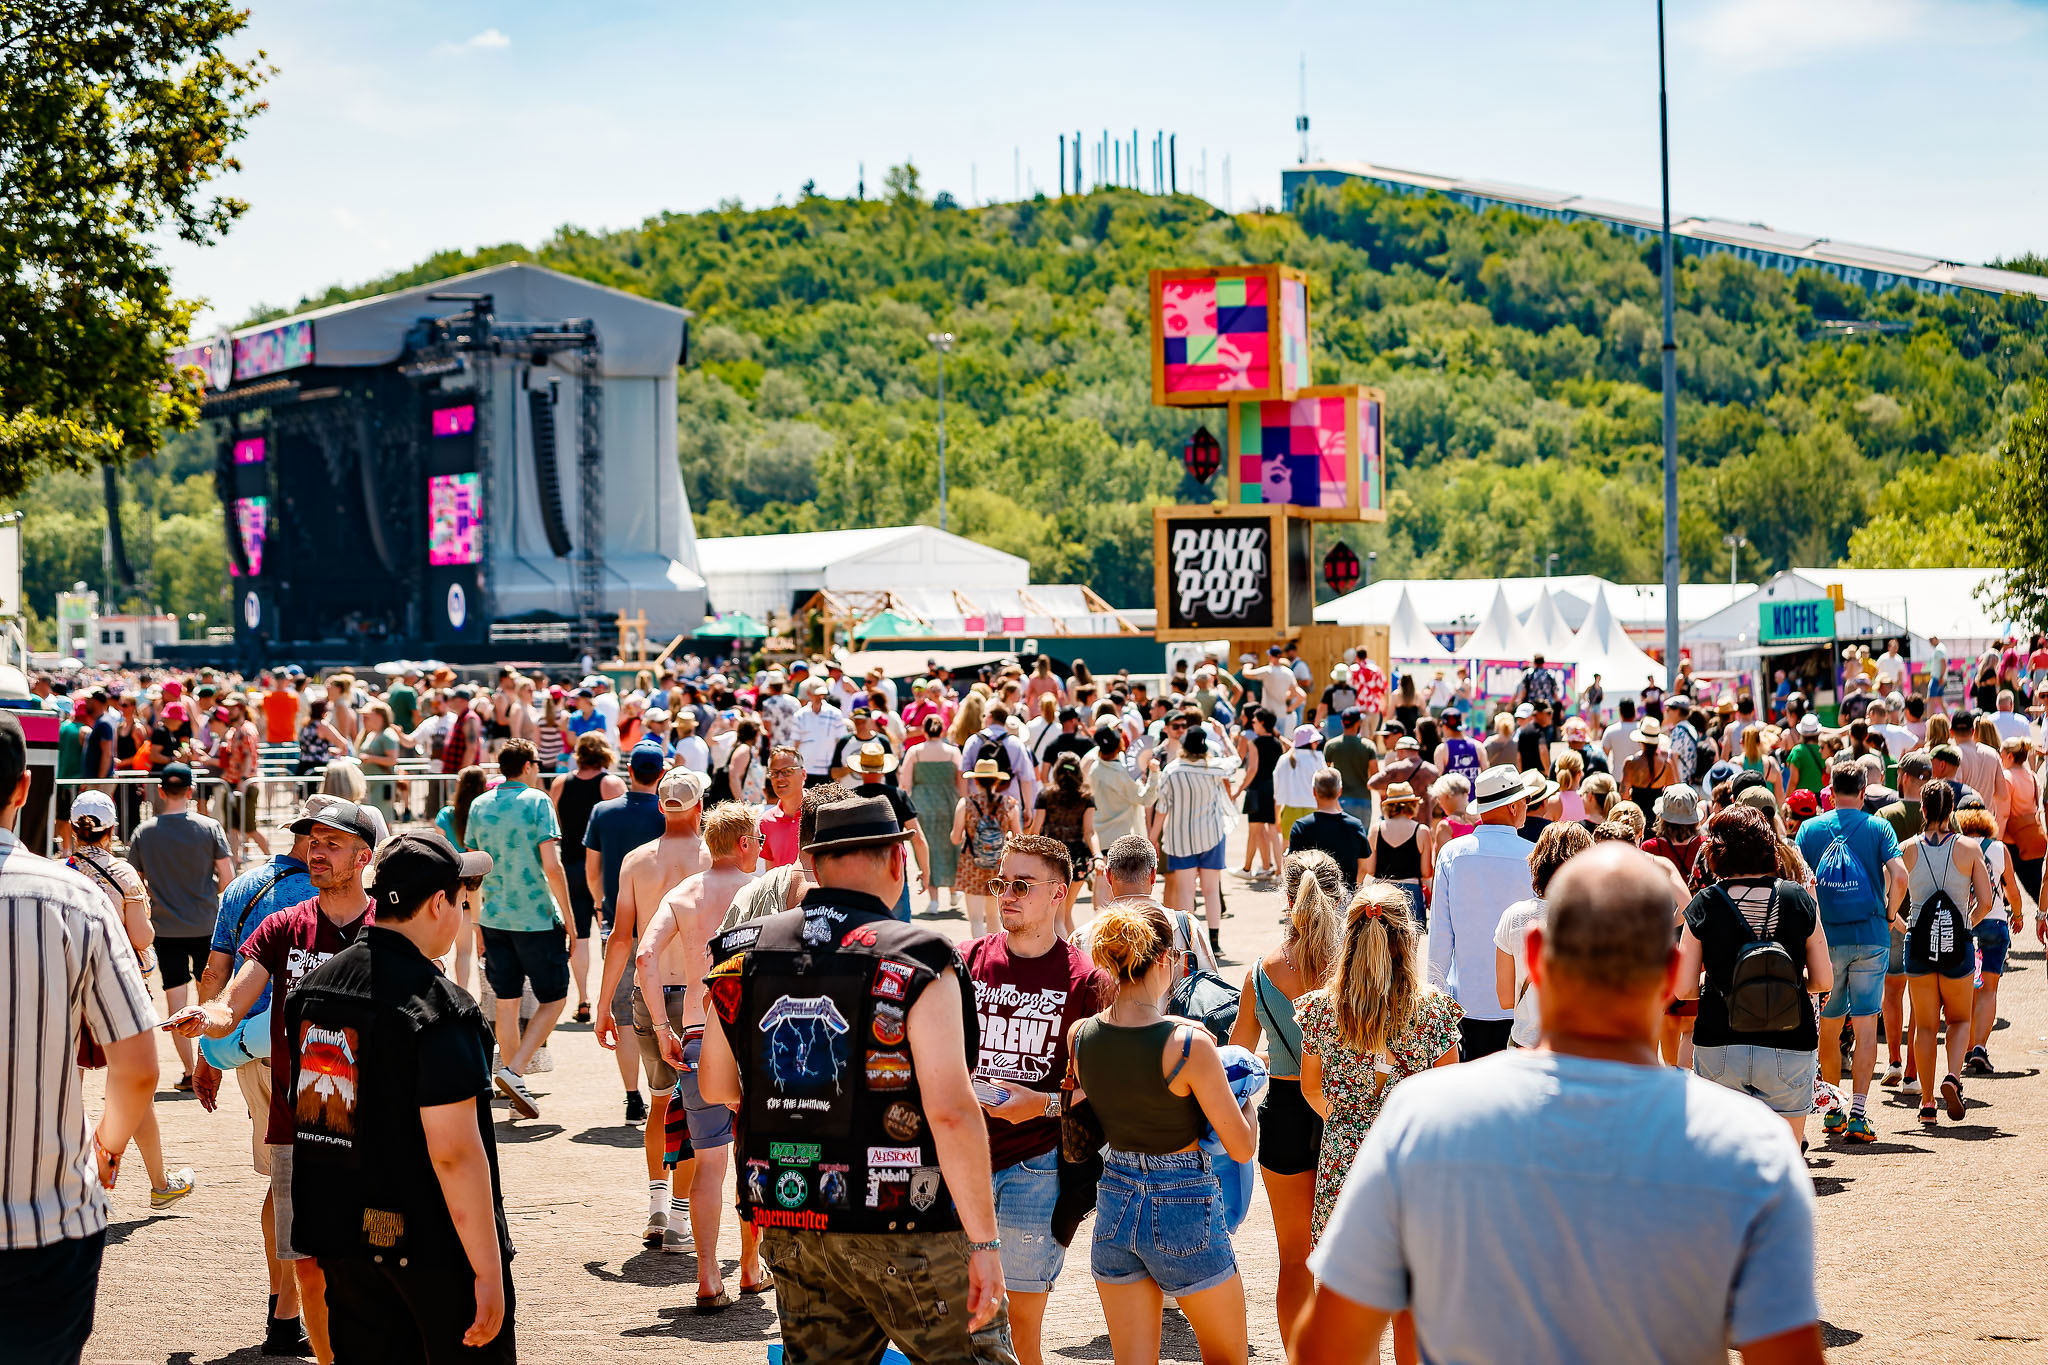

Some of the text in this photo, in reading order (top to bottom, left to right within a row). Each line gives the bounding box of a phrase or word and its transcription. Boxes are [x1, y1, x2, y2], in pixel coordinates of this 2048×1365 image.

[1172, 528, 1265, 576] PINK
[1177, 569, 1262, 617] POP
[1773, 604, 1820, 636] KOFFIE
[1827, 880, 1859, 889] NOVARTIS
[1940, 926, 1954, 953] SWEAT
[1019, 1071, 1038, 1081] 2023
[782, 1098, 797, 1110] THE
[314, 1134, 325, 1143] OF
[868, 1167, 910, 1182] Sabbath
